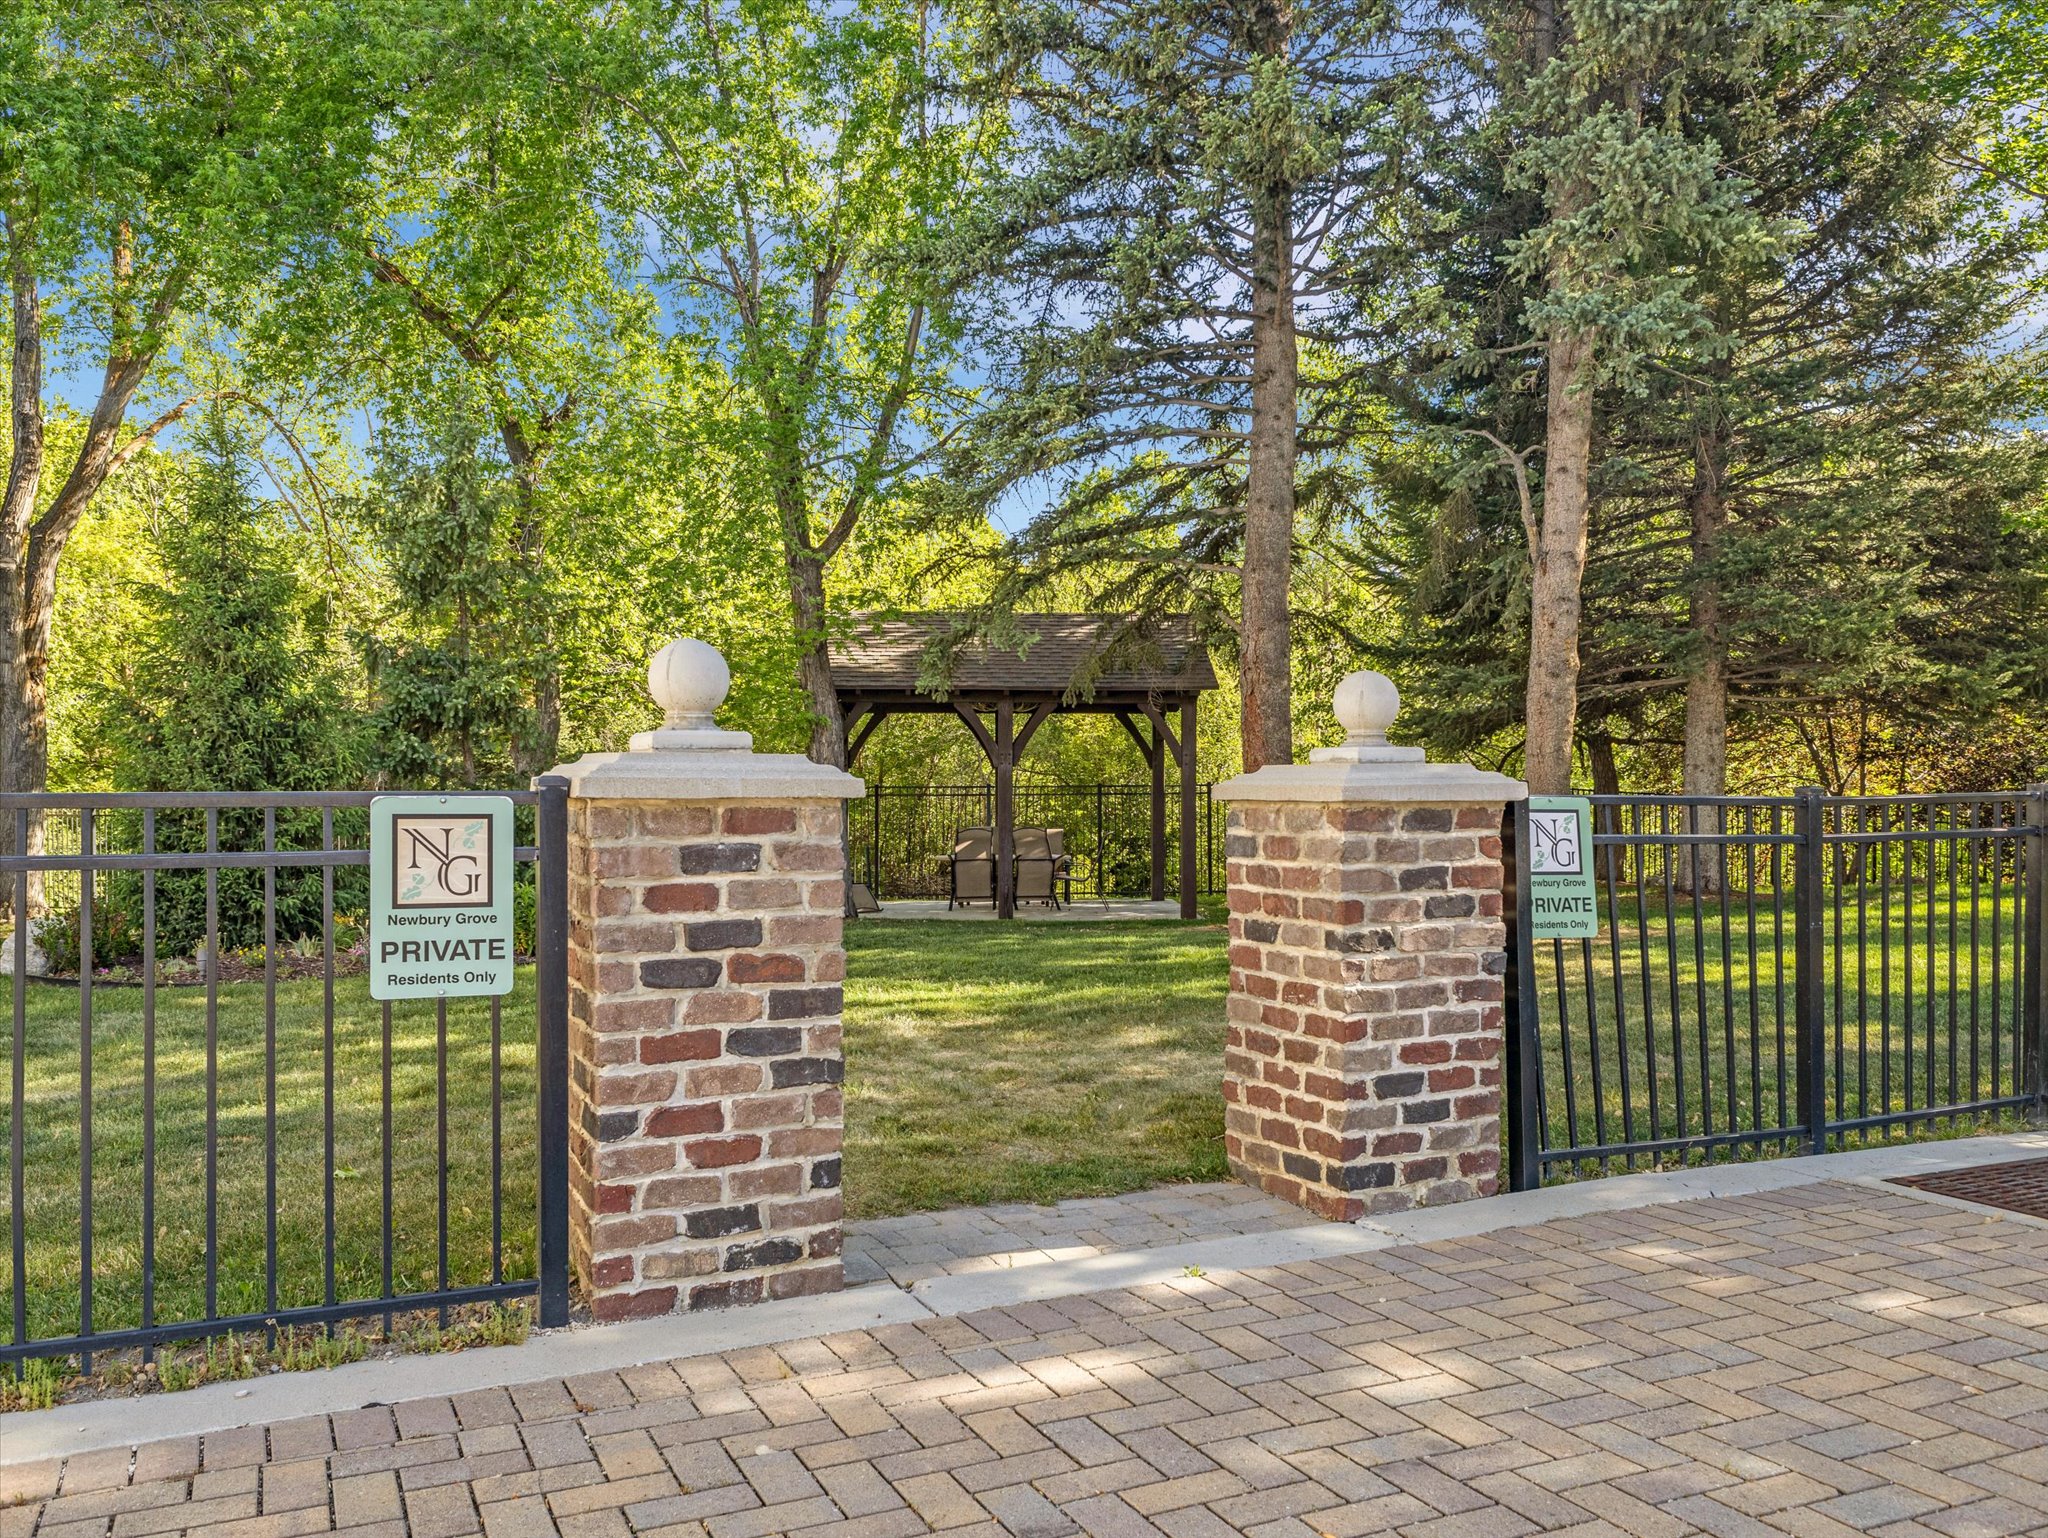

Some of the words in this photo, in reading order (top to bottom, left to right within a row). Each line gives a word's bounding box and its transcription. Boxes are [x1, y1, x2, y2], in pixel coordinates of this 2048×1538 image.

[1531, 879, 1561, 890] ewbury
[1563, 878, 1586, 887] Grove
[1531, 897, 1593, 913] RIVATE
[388, 914, 451, 927] Newbury
[455, 912, 498, 925] Grove
[1570, 920, 1589, 930] Only
[381, 938, 506, 963] PRIVATE
[388, 972, 459, 986] Residents
[464, 971, 497, 985] Only
